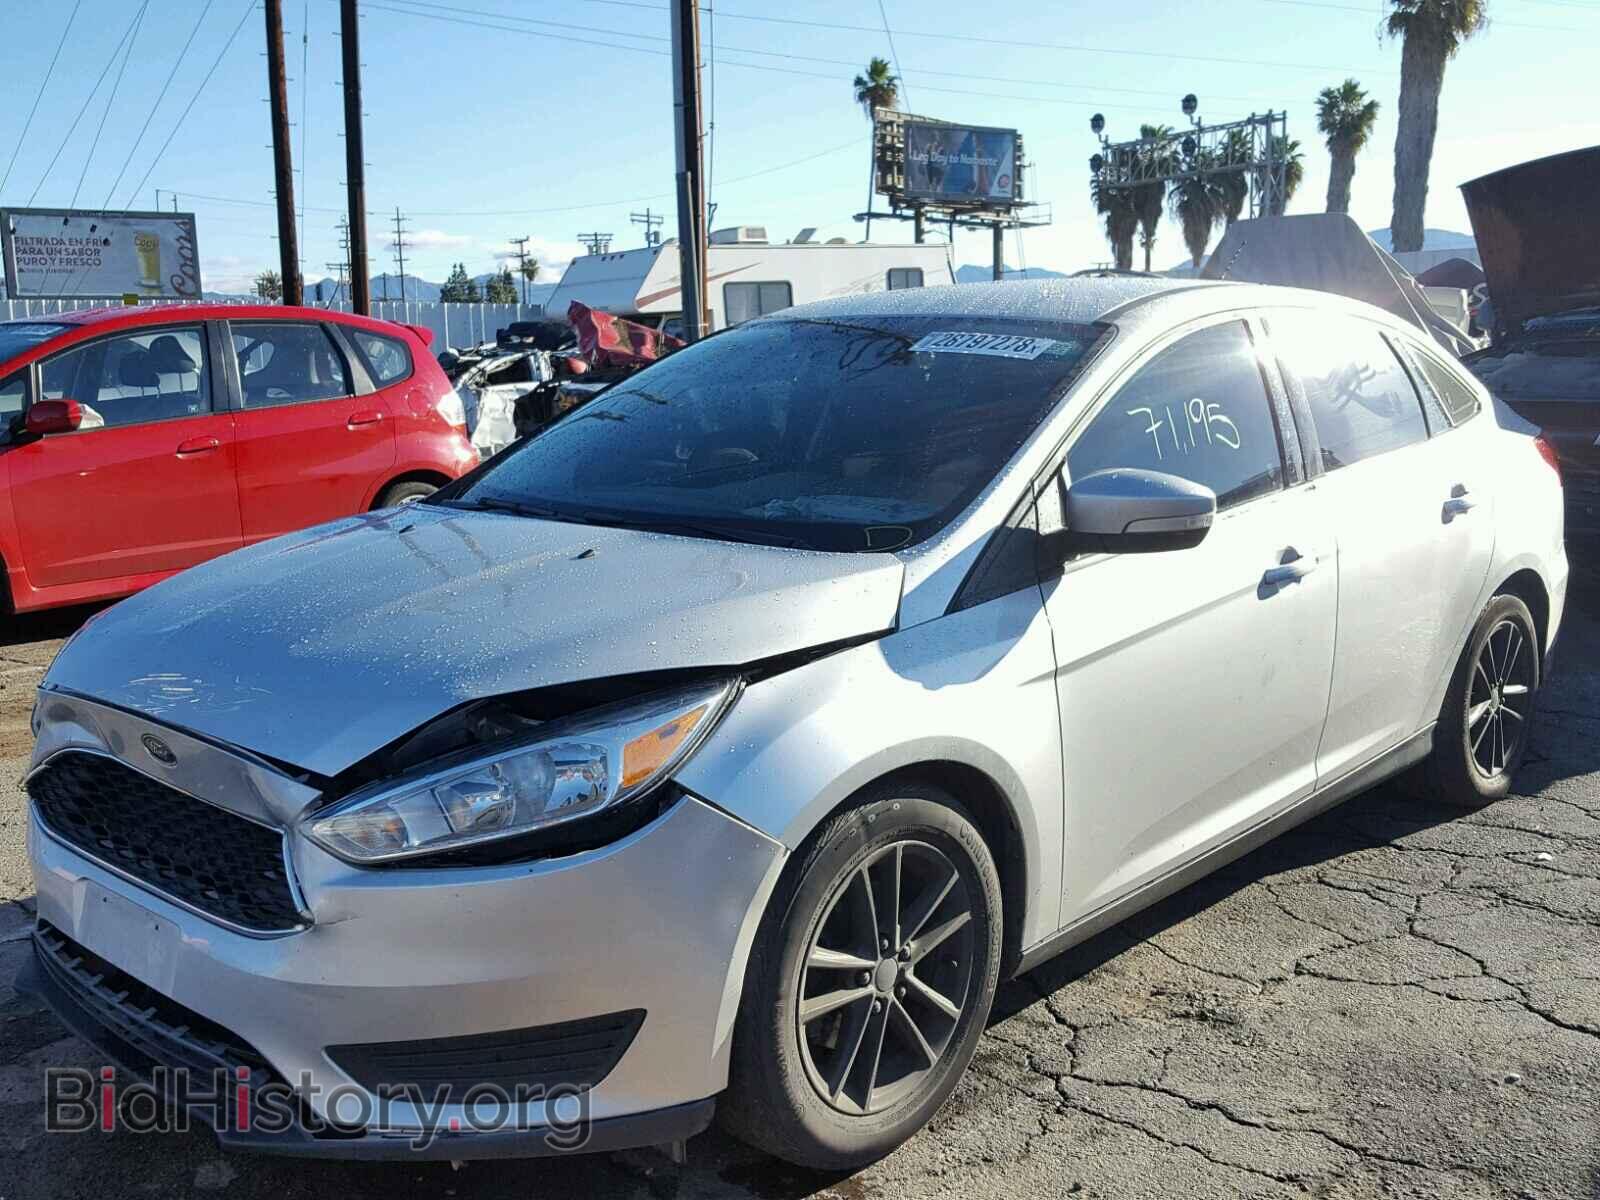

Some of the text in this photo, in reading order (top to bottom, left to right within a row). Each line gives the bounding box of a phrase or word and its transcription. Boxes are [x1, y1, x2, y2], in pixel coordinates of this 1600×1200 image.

[15, 236, 108, 248] FILTRADA EN FRÍ
[15, 247, 101, 257] PARA UN SABOR
[16, 256, 102, 267] PURO Y FRESCO
[1126, 398, 1241, 460] 71,195
